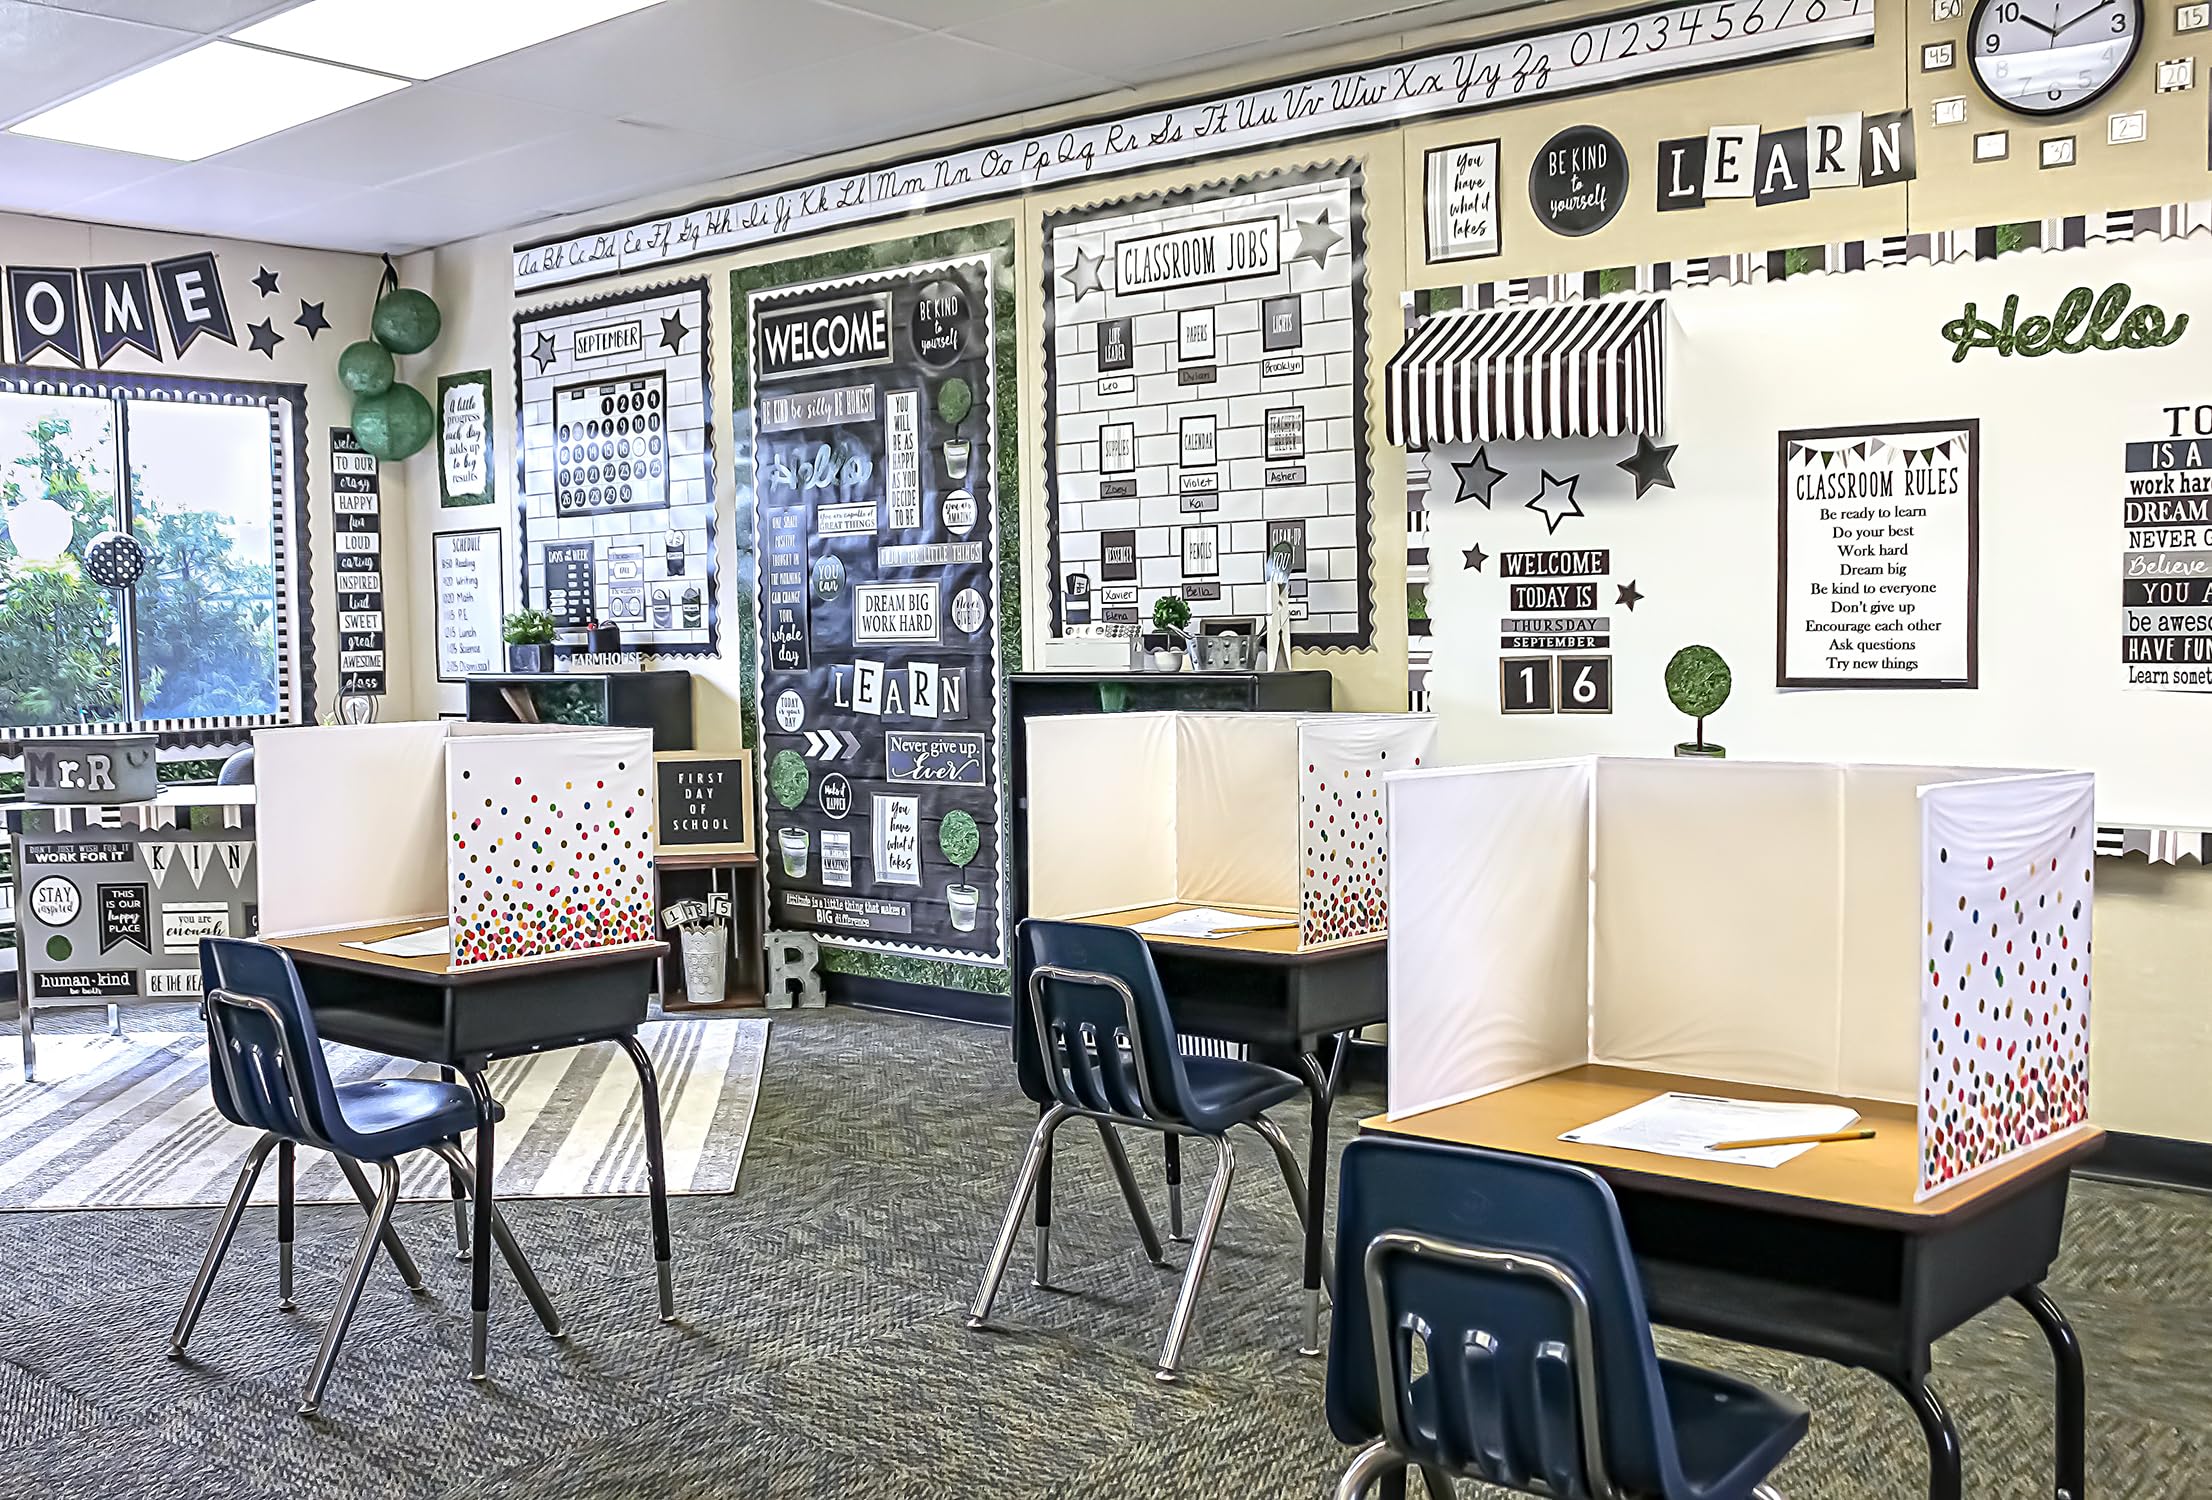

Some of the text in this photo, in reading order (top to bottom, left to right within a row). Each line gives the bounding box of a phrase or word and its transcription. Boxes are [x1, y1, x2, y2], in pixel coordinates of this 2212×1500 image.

[2111, 14, 2125, 32] 3
[2184, 9, 2202, 28] 15
[1986, 34, 2000, 53] 9
[1930, 47, 1950, 64] 45
[800, 43, 1551, 215] Kk Ll Mm Nn Oo Pp Qq Rr Ss Tt Uu Vv Ww Xx Yy Zz
[1457, 153, 1484, 174] You
[1550, 144, 1607, 176] BE KIND
[1668, 122, 1902, 197] LEARN
[1454, 174, 1486, 192] have
[1571, 174, 1583, 192] to
[1450, 195, 1478, 217] what
[1550, 184, 1607, 218] yourself
[1453, 220, 1487, 238] takes
[1125, 228, 1268, 285] CLASSROOM JOBS
[920, 296, 958, 321] BE KIND
[934, 320, 942, 334] to
[1272, 314, 1292, 334] LIGHTS
[1942, 283, 2189, 363] Hello
[577, 326, 638, 354] SEPTEMBER
[764, 310, 886, 366] WELCOME
[1186, 323, 1208, 343] PAPERS
[922, 330, 958, 354] yourself
[1266, 362, 1300, 374] Brooklyn
[1102, 382, 1118, 391] Leo
[896, 395, 908, 412] YOU
[448, 414, 480, 427] progress
[1184, 432, 1213, 450] CALENDAR
[892, 452, 914, 470] HAPPY
[2152, 441, 2202, 469] IS A
[336, 456, 374, 471] TO OUR
[1184, 477, 1213, 488] Violet
[1270, 471, 1298, 482] Asher
[1796, 466, 1958, 500] CLASSROOM RULES
[2130, 472, 2174, 495] work
[340, 496, 372, 510] HAPPY
[1820, 506, 1927, 522] Be ready to learn
[2126, 500, 2208, 524] DREAM
[820, 519, 875, 530] GREAT THINGS
[1832, 525, 1914, 541] Do your best
[2129, 530, 2196, 548] NEVER
[345, 536, 370, 550] LOUD
[452, 536, 481, 552] SCHEDULE
[1189, 542, 1212, 560] PENCILS
[1838, 543, 1908, 557] Work hard
[953, 545, 980, 560] THINGS
[342, 556, 373, 570] caring
[1272, 552, 1290, 570] YOU
[1506, 551, 1602, 576] WELCOME
[2128, 553, 2208, 576] Believe
[818, 564, 840, 580] YOU
[1840, 562, 1907, 577] Dream big
[340, 576, 378, 590] INSPIRED
[818, 580, 838, 592] can
[1186, 585, 1213, 596] Bella
[1811, 582, 1937, 598] Be kind to everyone
[1105, 590, 1133, 601] Xavier
[1516, 585, 1592, 608] TODAY IS
[2142, 582, 2190, 604] YOU
[866, 593, 930, 612] DREAM BIG
[1831, 601, 1916, 616] Don't give up
[345, 614, 378, 628] SWEET
[862, 614, 932, 632] WORK HARD
[1105, 612, 1128, 621] Elena
[2128, 610, 2152, 632] be
[458, 627, 477, 638] Lunch
[1512, 618, 1598, 632] THURSDAY
[1806, 620, 1942, 634] Encourage each other
[348, 632, 375, 650] great
[772, 624, 803, 644] whole
[1514, 636, 1596, 648] SEPTEMBER
[1828, 639, 1916, 652] Ask questions
[2128, 638, 2176, 661] HAVE
[343, 655, 382, 668] AWESOME
[570, 652, 642, 666] FARMHOUSE
[778, 645, 800, 666] day
[1826, 657, 1918, 671] Try new things
[2129, 665, 2169, 684] Learn
[834, 668, 960, 714] LEARN
[780, 696, 799, 709] TODAY
[784, 716, 796, 728] DAY
[890, 736, 980, 758] Never give up.
[892, 752, 980, 781] Ever.
[678, 772, 724, 784] FIRST
[685, 788, 714, 800] DAY
[689, 804, 706, 815] OF
[891, 801, 910, 816] You
[673, 819, 728, 830] SCHOOL
[890, 817, 911, 832] have
[886, 836, 905, 850] what
[35, 850, 125, 862] WORK FOR IT
[888, 854, 912, 870] takes
[38, 886, 71, 903] STAY
[111, 890, 134, 898] THIS
[106, 900, 141, 908] IS OUR
[108, 910, 140, 924] happy
[178, 916, 212, 926] you are
[816, 911, 870, 928] BIG difference
[109, 924, 140, 933] PLACE
[764, 931, 827, 1009] R
